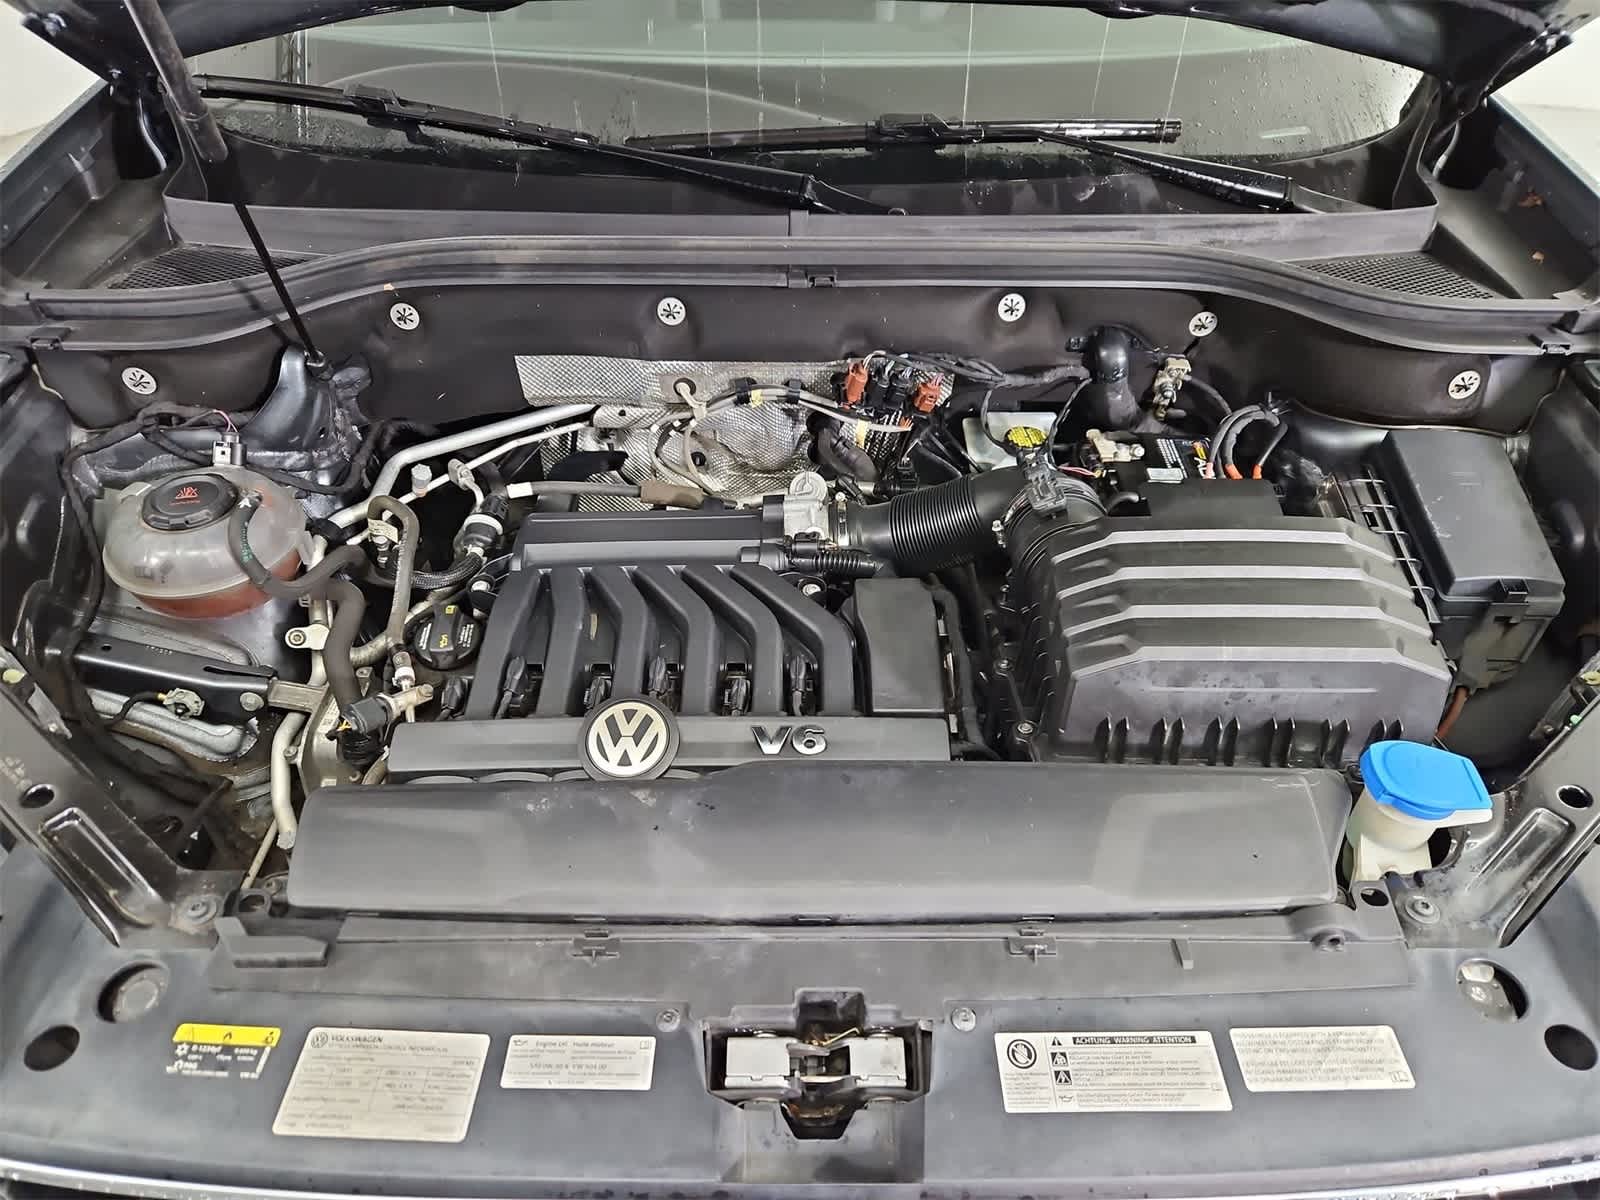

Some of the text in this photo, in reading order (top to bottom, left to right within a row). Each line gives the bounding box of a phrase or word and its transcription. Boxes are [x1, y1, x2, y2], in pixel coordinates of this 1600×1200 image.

[588, 701, 670, 777] VW
[752, 725, 827, 755] V6
[1075, 1036, 1192, 1044] ACHTUNG WARNING ATTENTION
